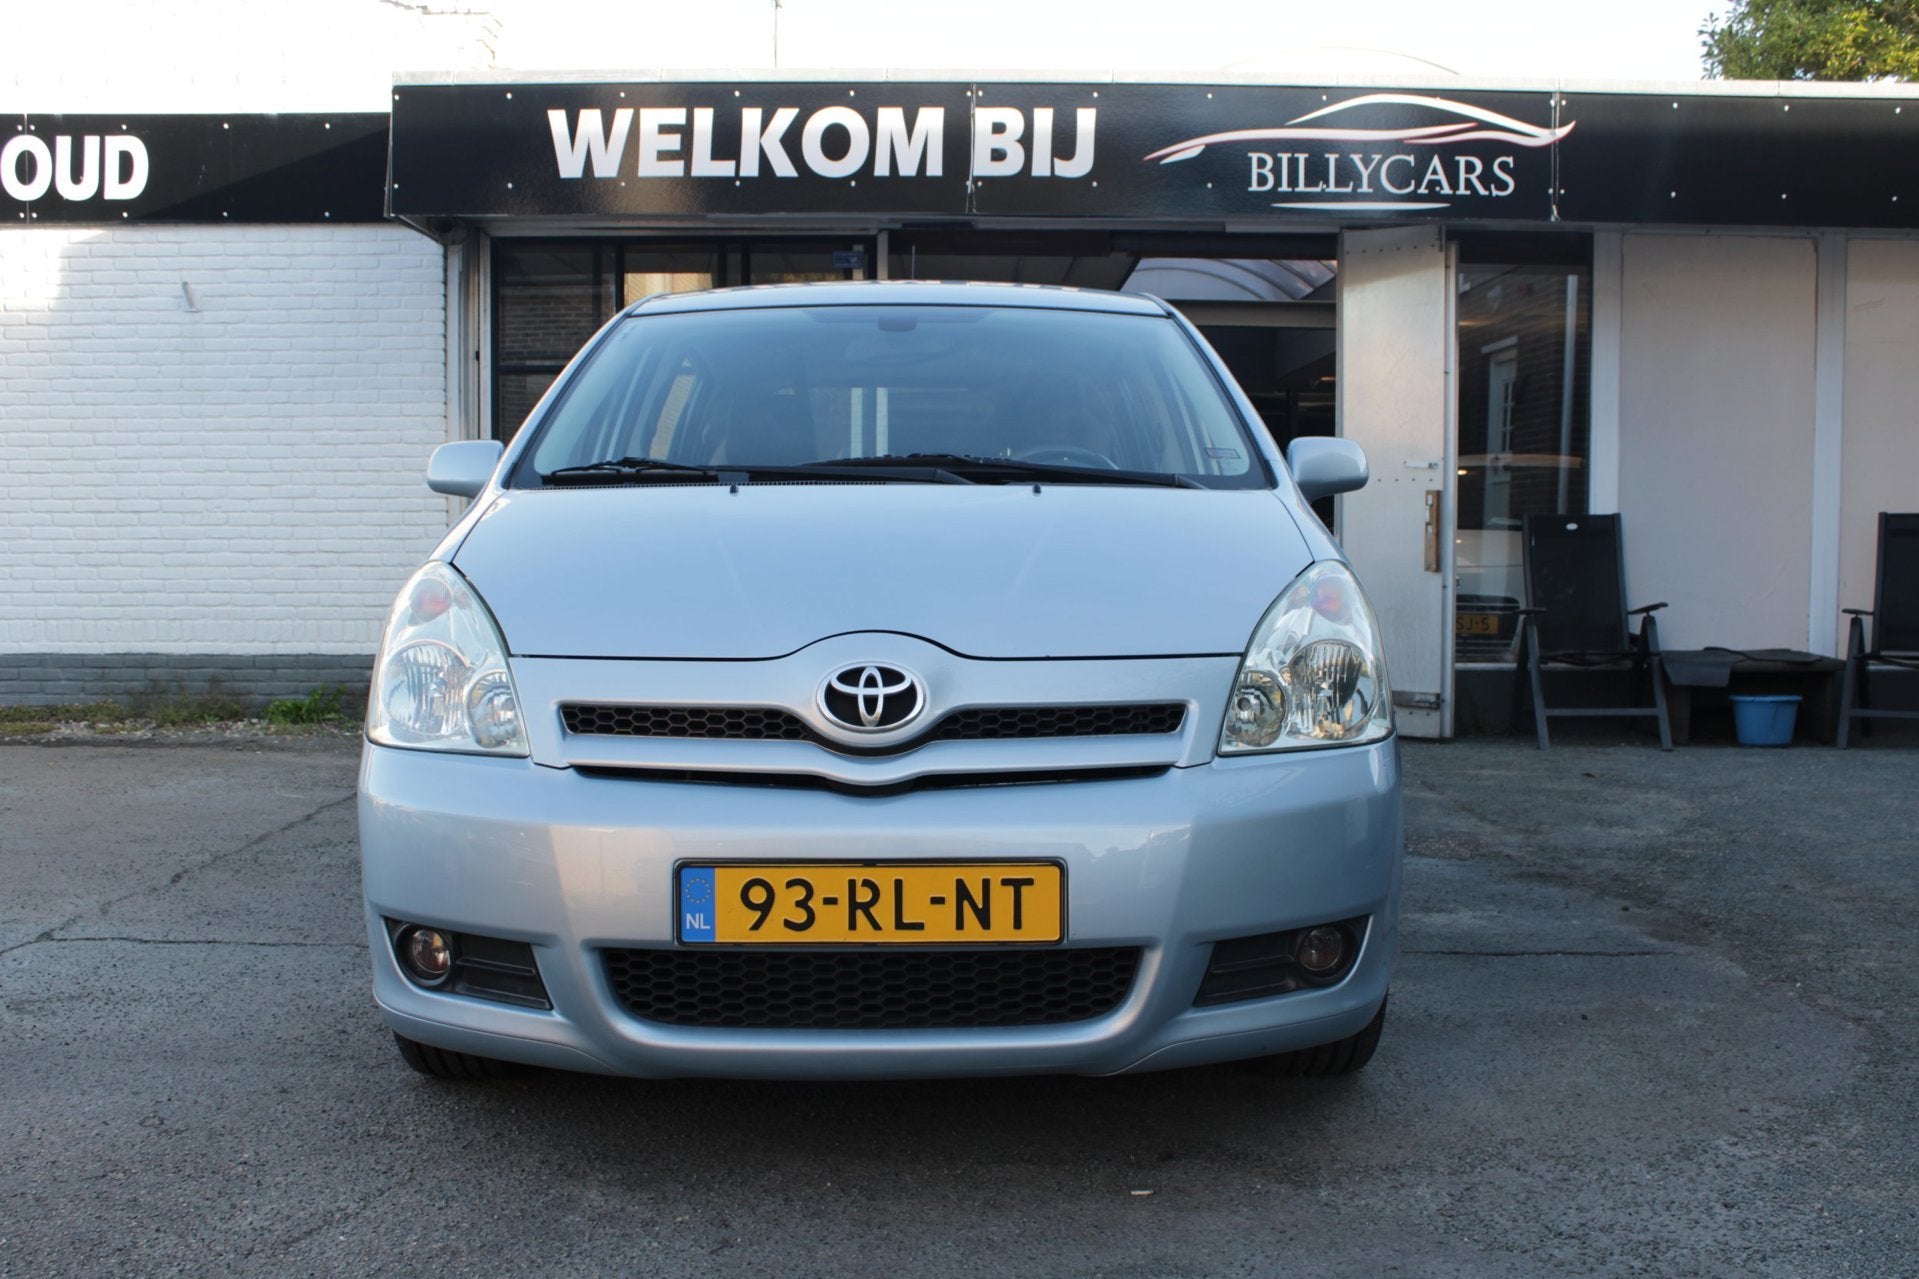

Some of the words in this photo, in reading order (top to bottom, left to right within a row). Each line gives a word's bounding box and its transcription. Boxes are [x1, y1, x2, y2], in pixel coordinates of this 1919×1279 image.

[0, 134, 149, 201] OUD
[548, 106, 944, 178] WELKOM
[974, 106, 1098, 178] BIJ
[1247, 152, 1515, 197] BILLYCARS
[686, 913, 710, 930] NL
[740, 877, 1035, 932] 93-RL-NT
